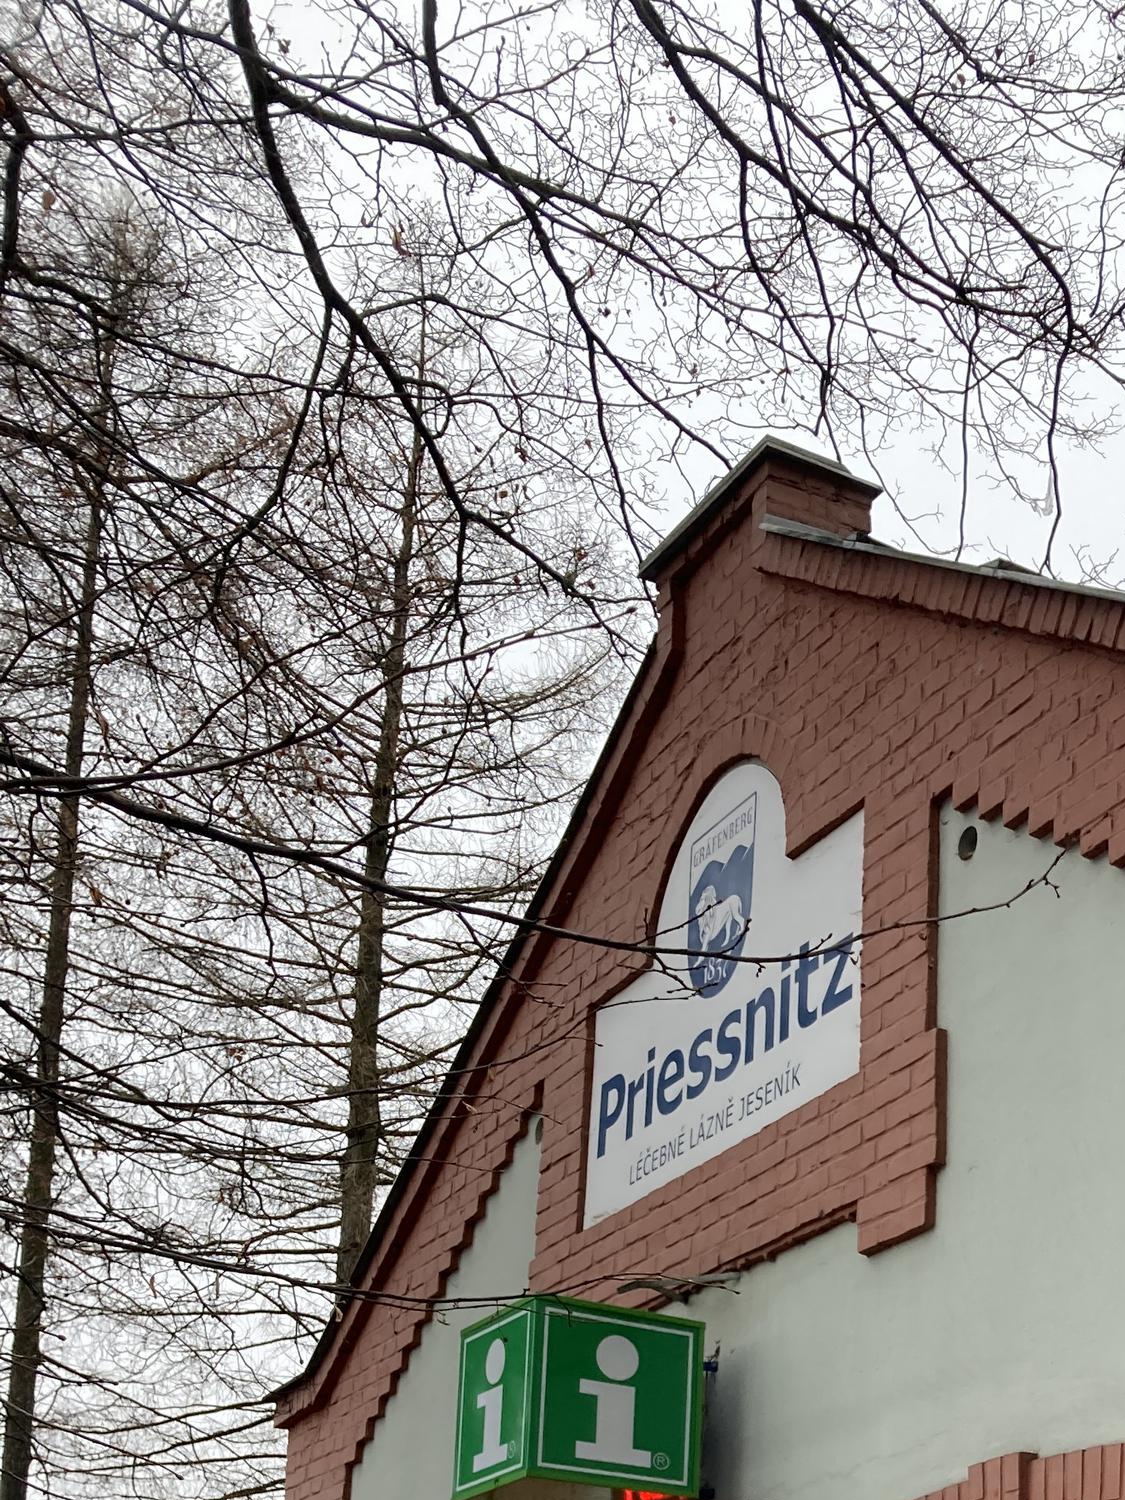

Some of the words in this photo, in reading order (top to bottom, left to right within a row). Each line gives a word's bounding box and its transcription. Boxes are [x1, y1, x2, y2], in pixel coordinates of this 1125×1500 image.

[597, 932, 853, 1159] Priessnitz
[629, 1125, 686, 1186] LÉČEBNÉ
[690, 1097, 734, 1150] LÁZNĚ
[738, 1061, 801, 1122] JESENÍK
